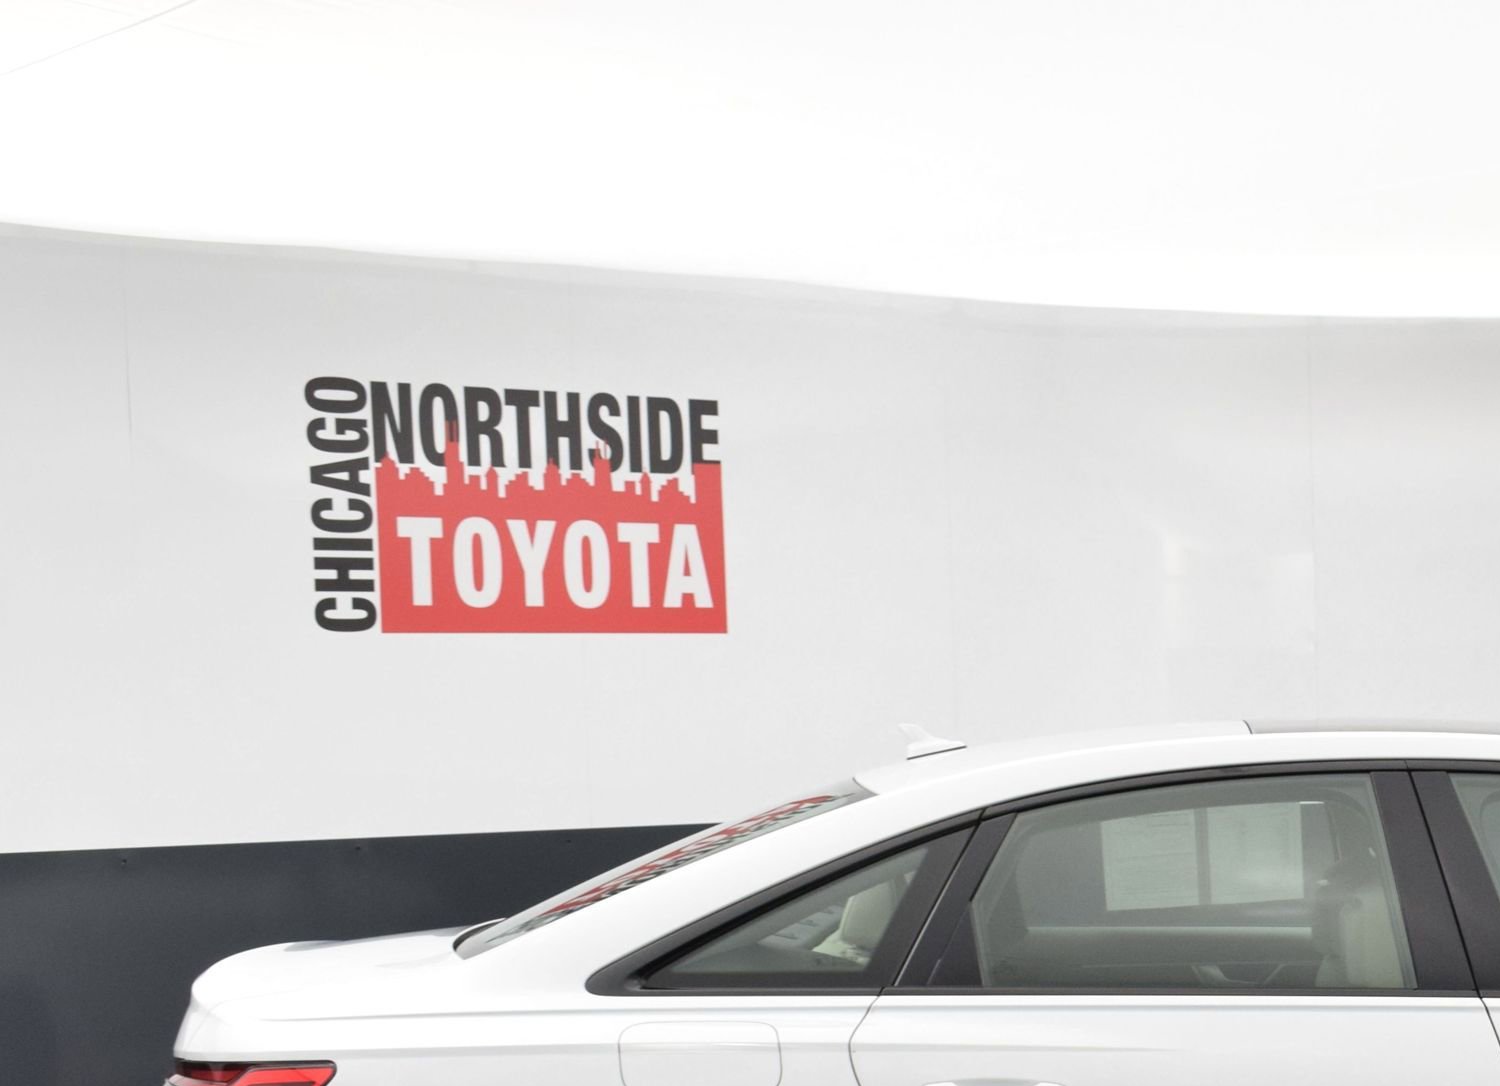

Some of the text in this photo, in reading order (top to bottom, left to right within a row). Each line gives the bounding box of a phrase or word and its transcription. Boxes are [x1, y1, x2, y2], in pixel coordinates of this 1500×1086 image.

[370, 381, 721, 474] NORTHSIDE
[304, 376, 377, 632] CHICAGO
[396, 516, 714, 609] TOYOTA
